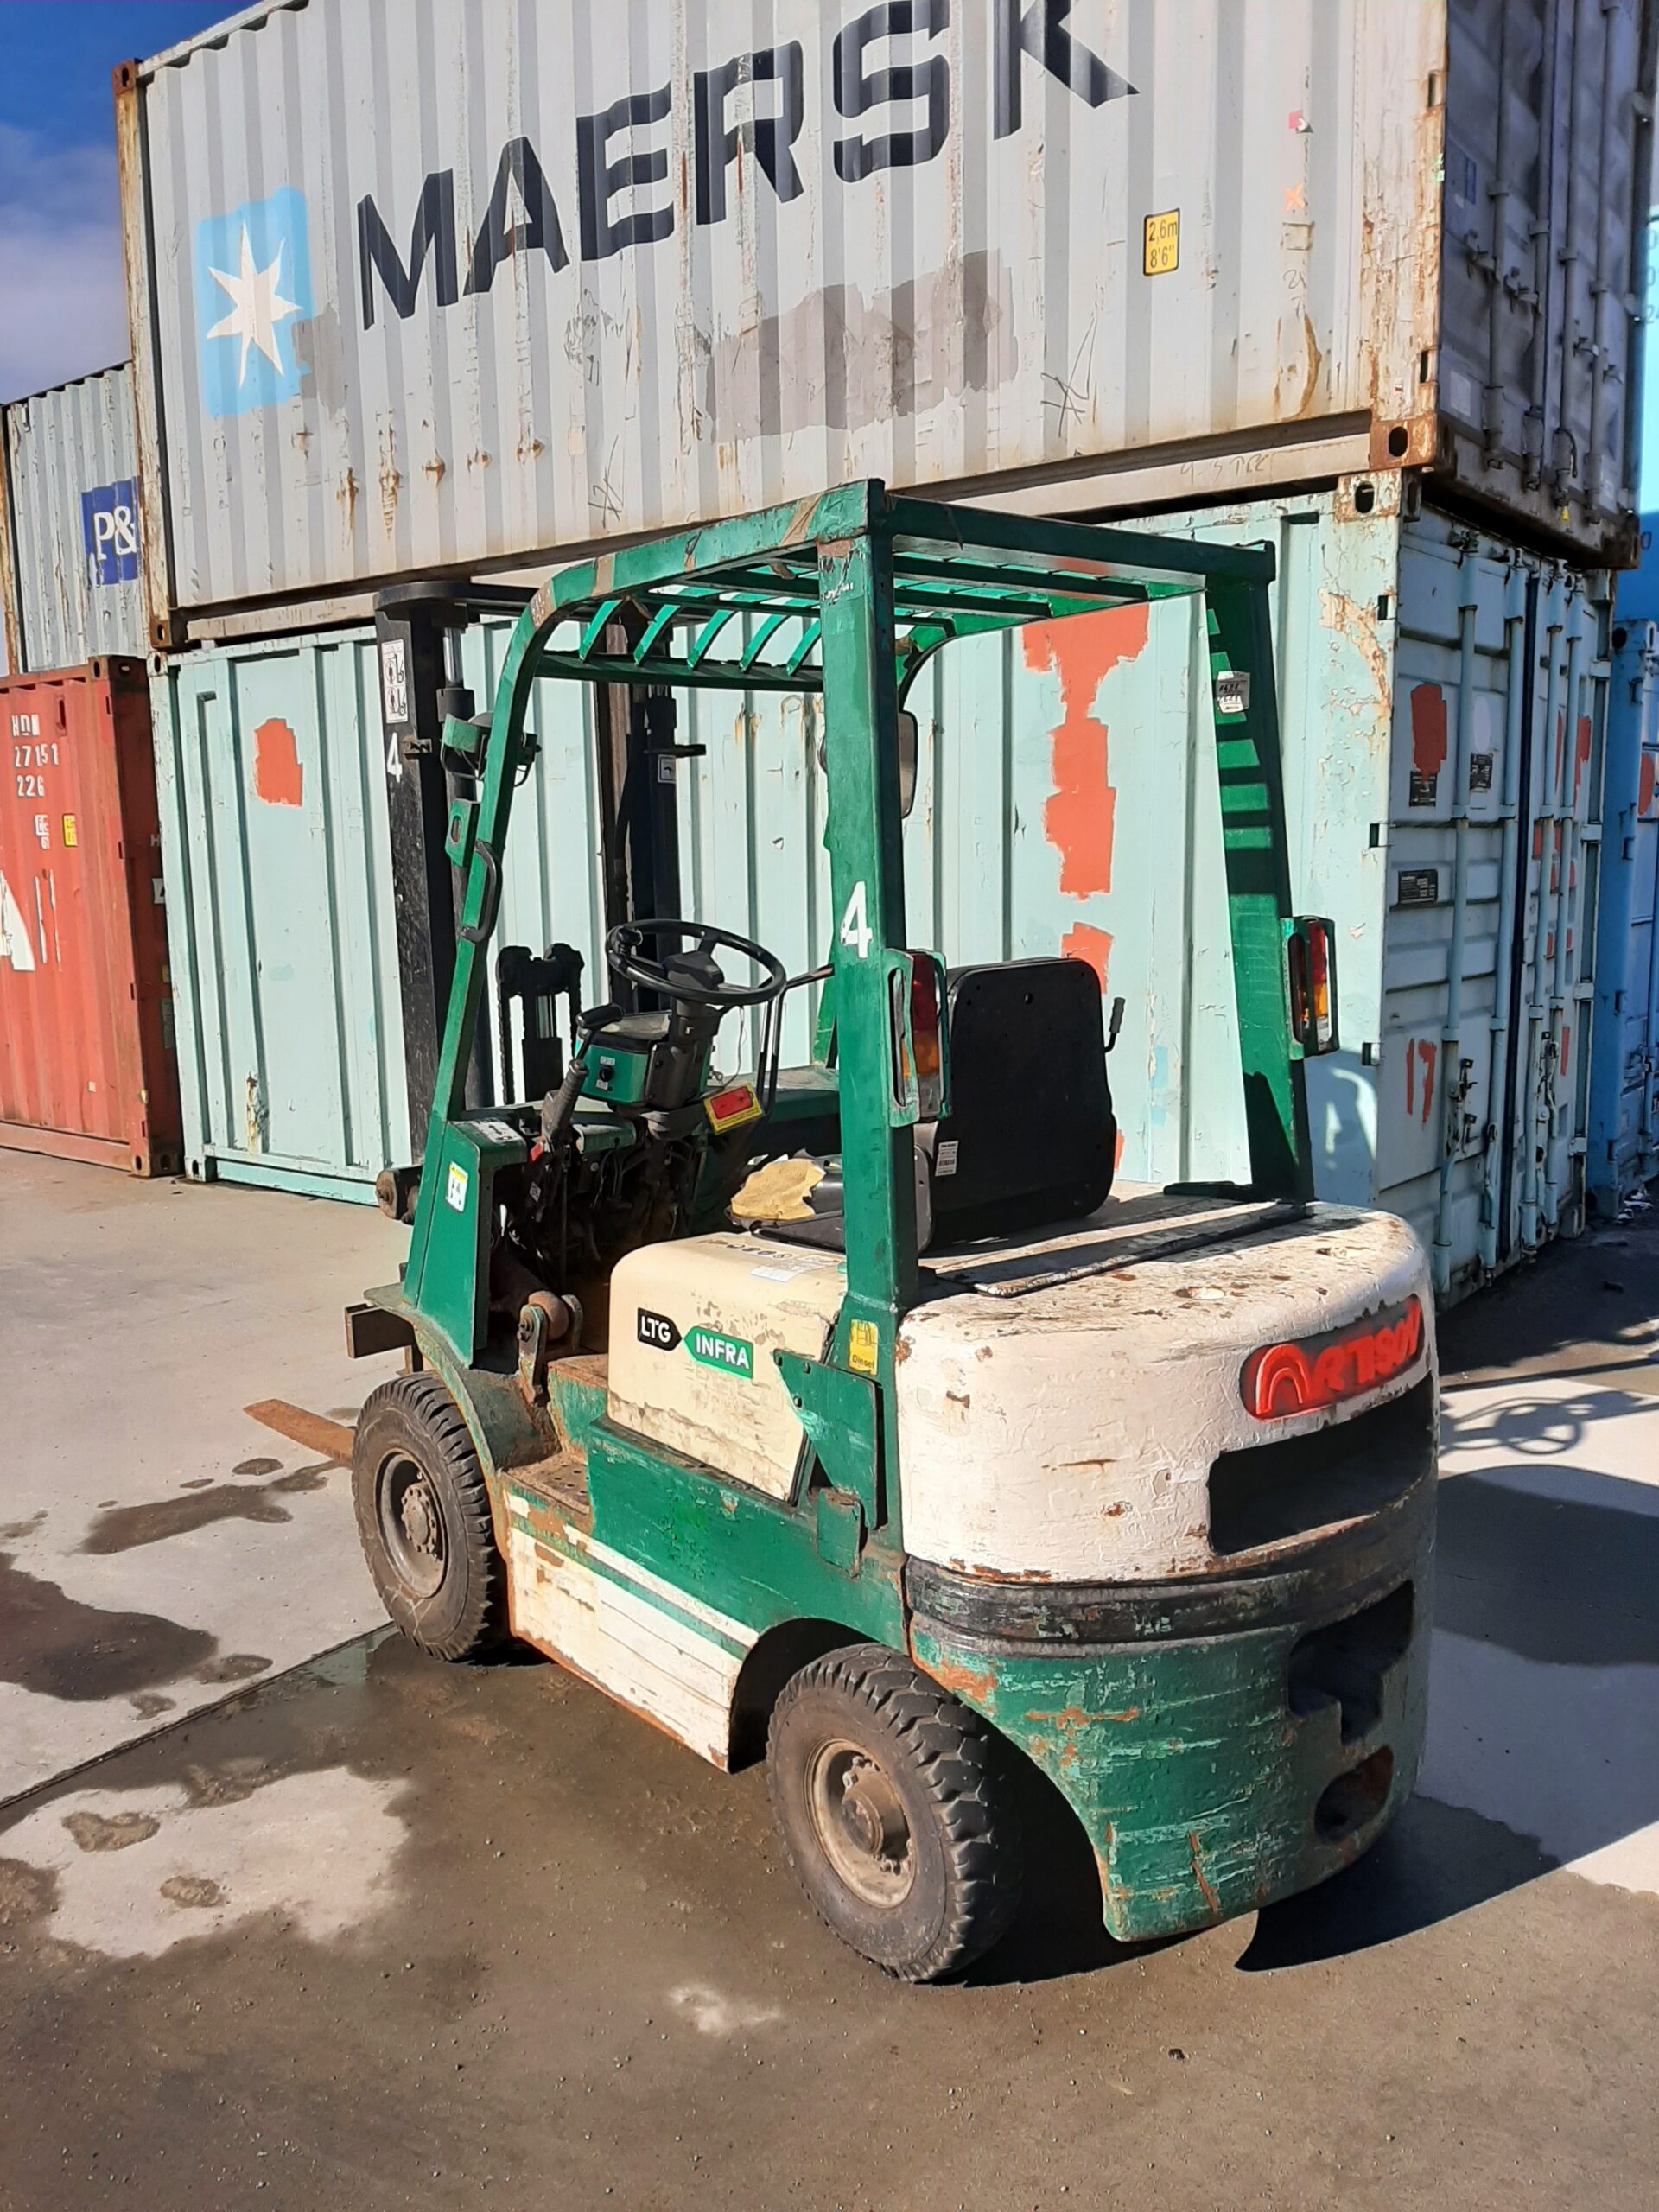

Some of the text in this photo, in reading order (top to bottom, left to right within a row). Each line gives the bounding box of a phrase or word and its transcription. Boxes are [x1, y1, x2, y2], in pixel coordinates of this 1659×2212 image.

[356, 0, 1141, 332] MAERSK
[1148, 219, 1178, 244] 2,6m
[387, 732, 403, 783] 4
[840, 880, 873, 958] 4
[641, 1316, 750, 1370] LTG INFRA
[852, 1354, 874, 1370] Diesel
